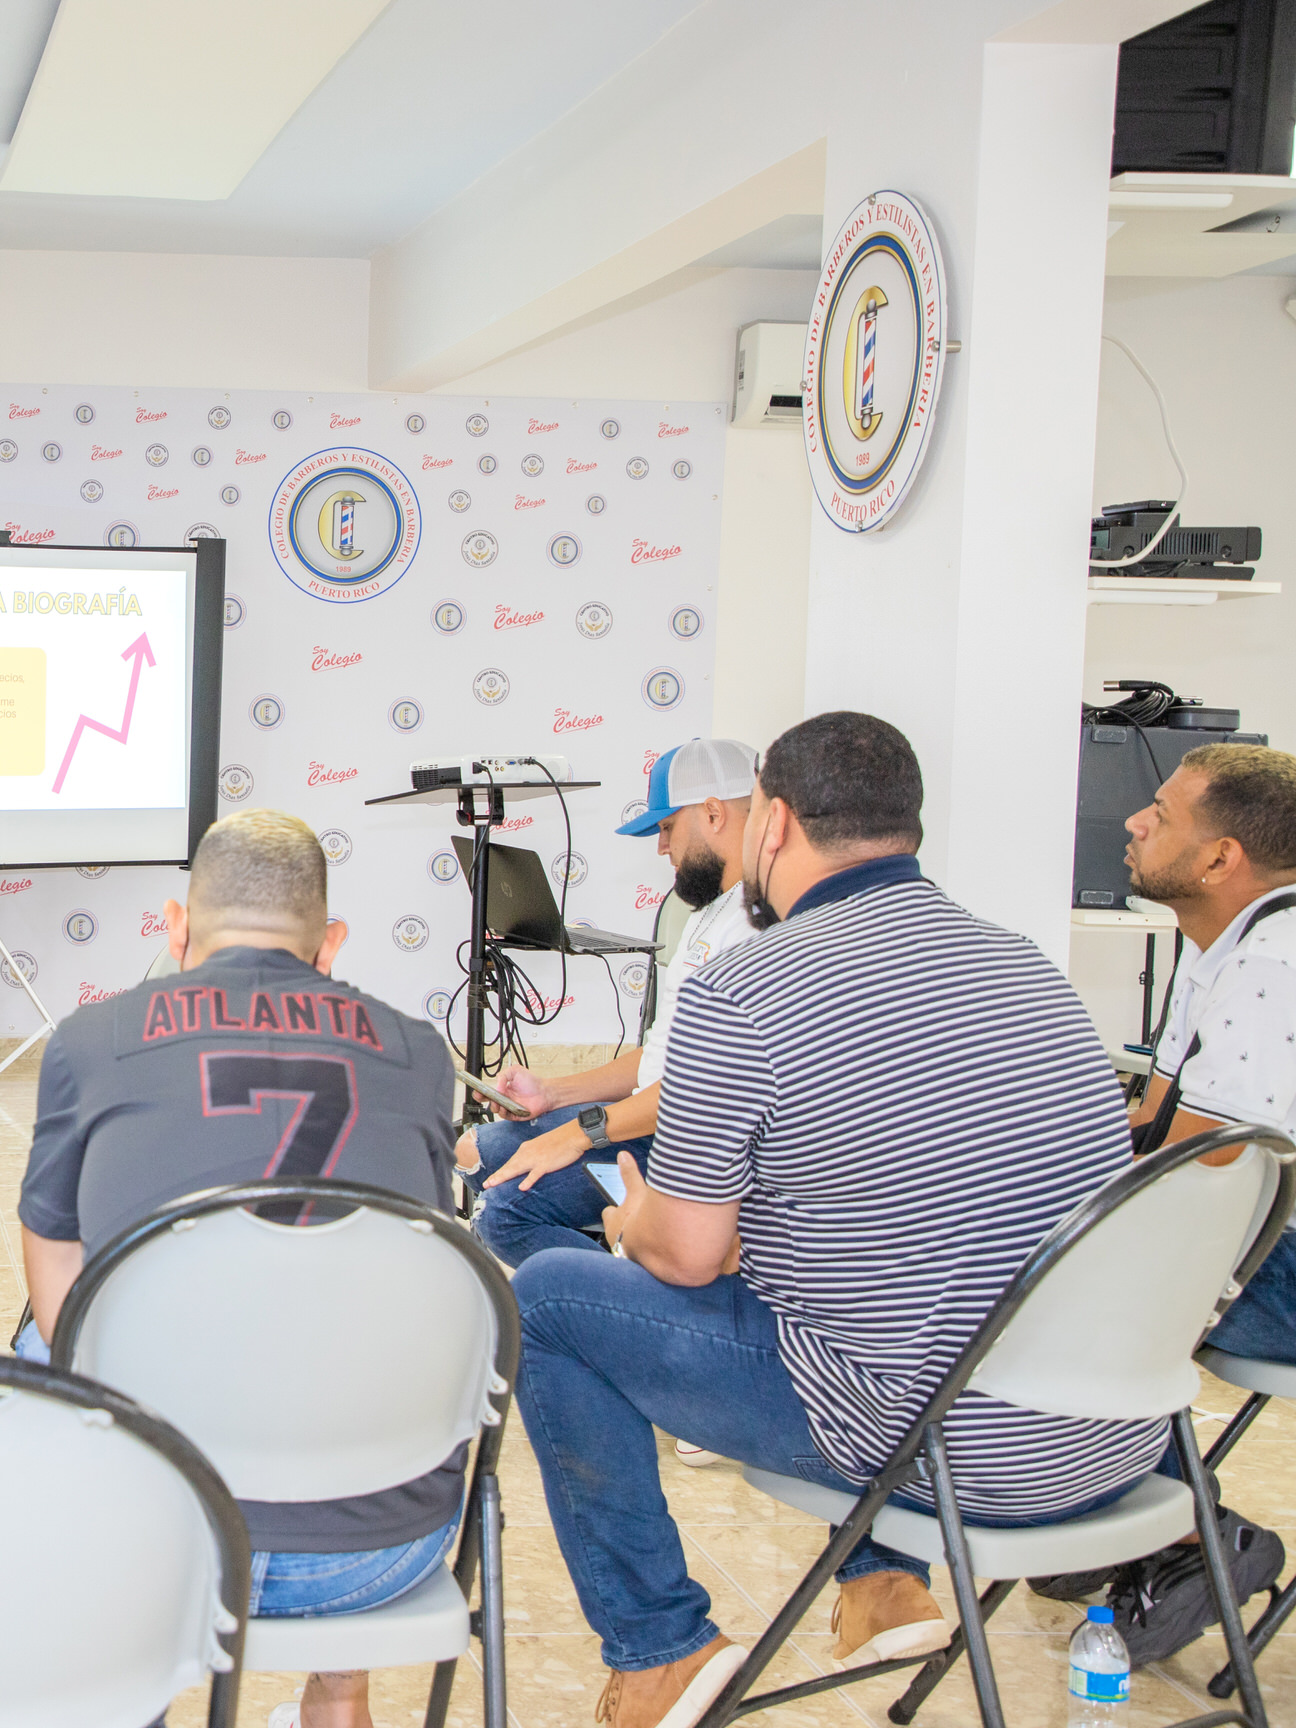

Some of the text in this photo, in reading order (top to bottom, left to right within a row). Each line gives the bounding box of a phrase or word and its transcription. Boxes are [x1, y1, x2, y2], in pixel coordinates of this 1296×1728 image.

[867, 208, 874, 225] Y
[876, 203, 927, 264] ESTILISTAS
[818, 213, 865, 307] BARBEROS
[922, 263, 934, 296] EN
[810, 310, 822, 343] DE
[807, 349, 819, 453] COLEGIO
[9, 409, 40, 420] Colegio
[136, 413, 167, 424] Colegio
[329, 418, 360, 429] Colegio
[528, 423, 559, 434] Colegio
[658, 427, 689, 438] Colegio
[91, 450, 122, 461] Colegio
[235, 454, 266, 465] Colegio
[341, 453, 349, 462] Y
[855, 452, 870, 467] 1989
[287, 453, 339, 490] BARBEROS
[351, 453, 404, 491] ESTILISTAS
[422, 459, 453, 470] Colegio
[566, 463, 597, 474] Colegio
[147, 489, 178, 500] Colegio
[279, 490, 292, 505] DE
[400, 491, 413, 506] EN
[831, 479, 895, 522] PUERTO RICO
[515, 499, 546, 510] Colegio
[4, 522, 21, 531] Soy
[274, 508, 290, 559] COLEGIO
[397, 508, 416, 564] BARBERIA
[632, 539, 648, 548] Soy
[631, 546, 681, 565] Colegio
[308, 580, 380, 599] PUERTO RICO
[12, 586, 143, 617] BIOGRAFÍA
[495, 604, 511, 613] Soy
[494, 611, 544, 630] Colegio
[313, 646, 329, 655] Soy
[312, 653, 362, 672] Colegio
[0, 698, 15, 707] me
[554, 708, 570, 717] Soy
[553, 715, 603, 734] Colegio
[644, 750, 660, 759] Soy
[308, 761, 324, 770] Soy
[307, 768, 357, 787] Colegio
[490, 815, 534, 832] olegio
[636, 884, 652, 893] Soy
[142, 912, 158, 920] Soy
[79, 982, 96, 991] Soy
[142, 986, 383, 1051] ATLANTA
[200, 1049, 359, 1227] 7
